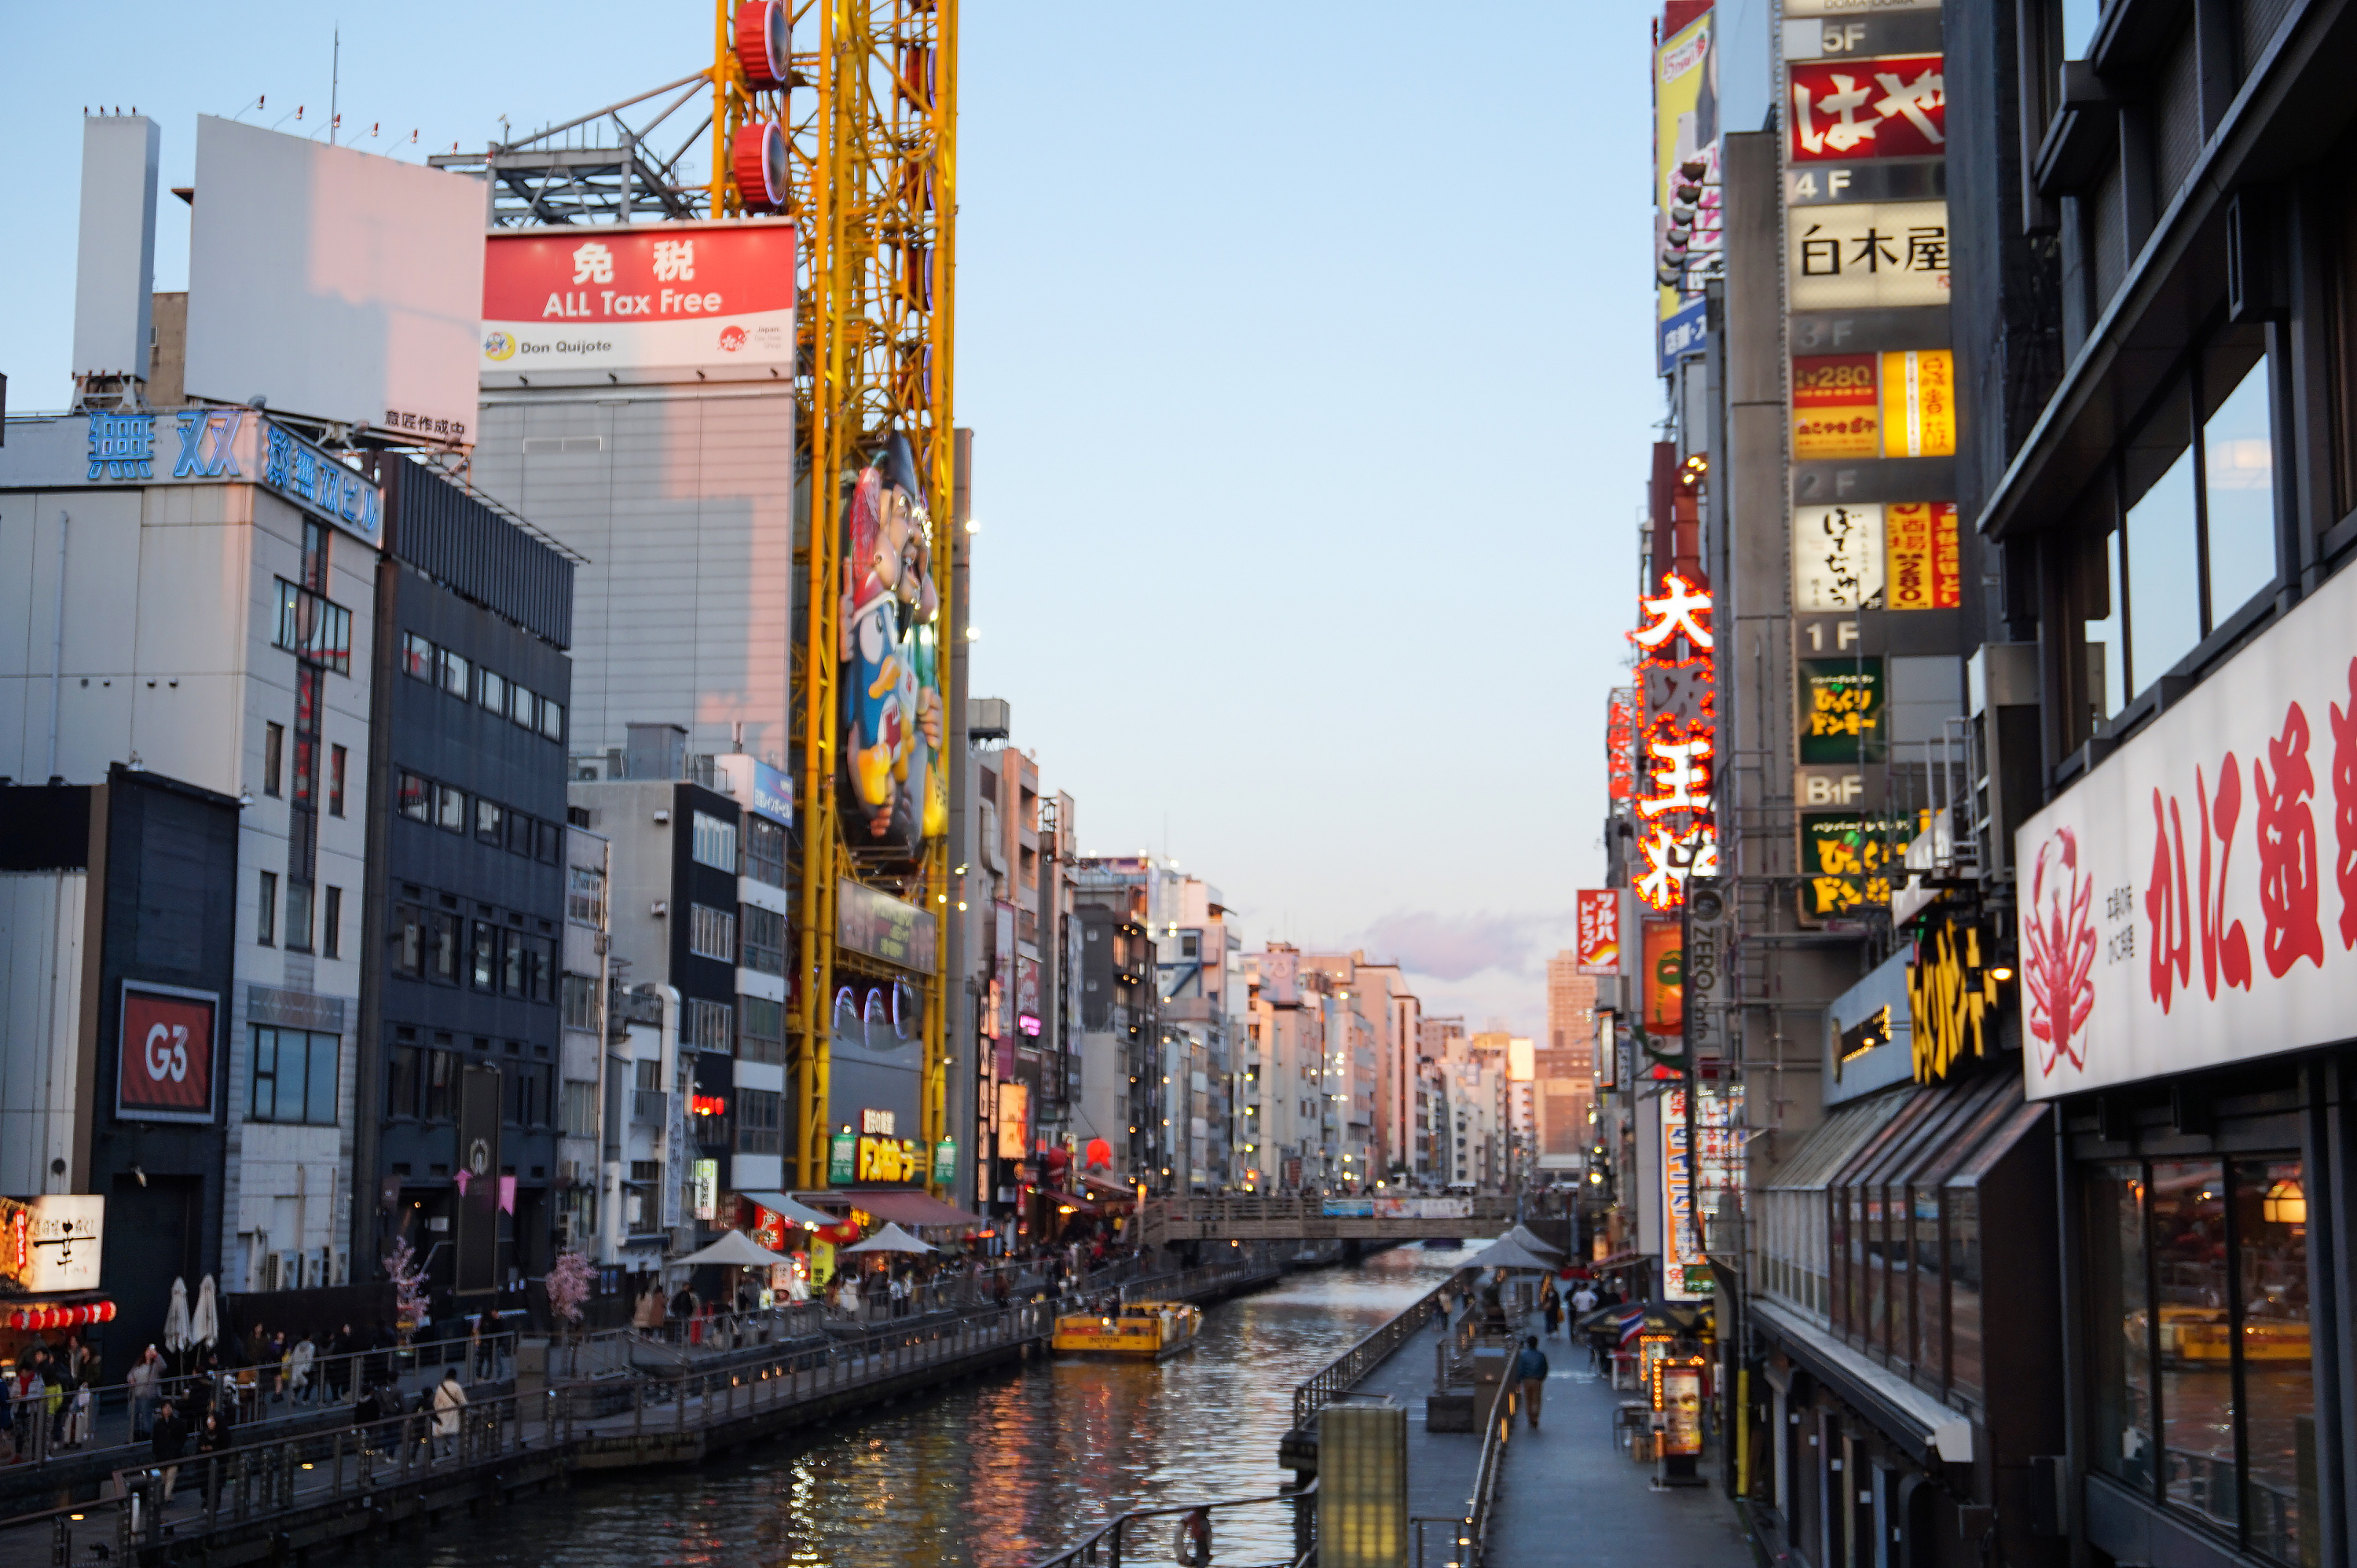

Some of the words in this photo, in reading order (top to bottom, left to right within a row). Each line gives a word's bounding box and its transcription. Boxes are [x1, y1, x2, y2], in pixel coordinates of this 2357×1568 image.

[1823, 23, 1866, 52] 5F
[572, 240, 693, 284] 免税
[1801, 224, 1950, 277] 白木屋
[542, 292, 591, 317] ALL
[600, 291, 651, 315] Tax
[660, 288, 722, 313] Free
[520, 342, 550, 354] Don
[555, 339, 611, 354] Quijote
[88, 412, 242, 478] 無双
[294, 446, 378, 531] 無双ビル
[1807, 775, 1863, 805] B1F
[1581, 901, 1596, 954] ドラッグ
[1596, 892, 1616, 942] ツルハ
[1694, 927, 1714, 990] ZERO
[145, 1022, 189, 1083] G3
